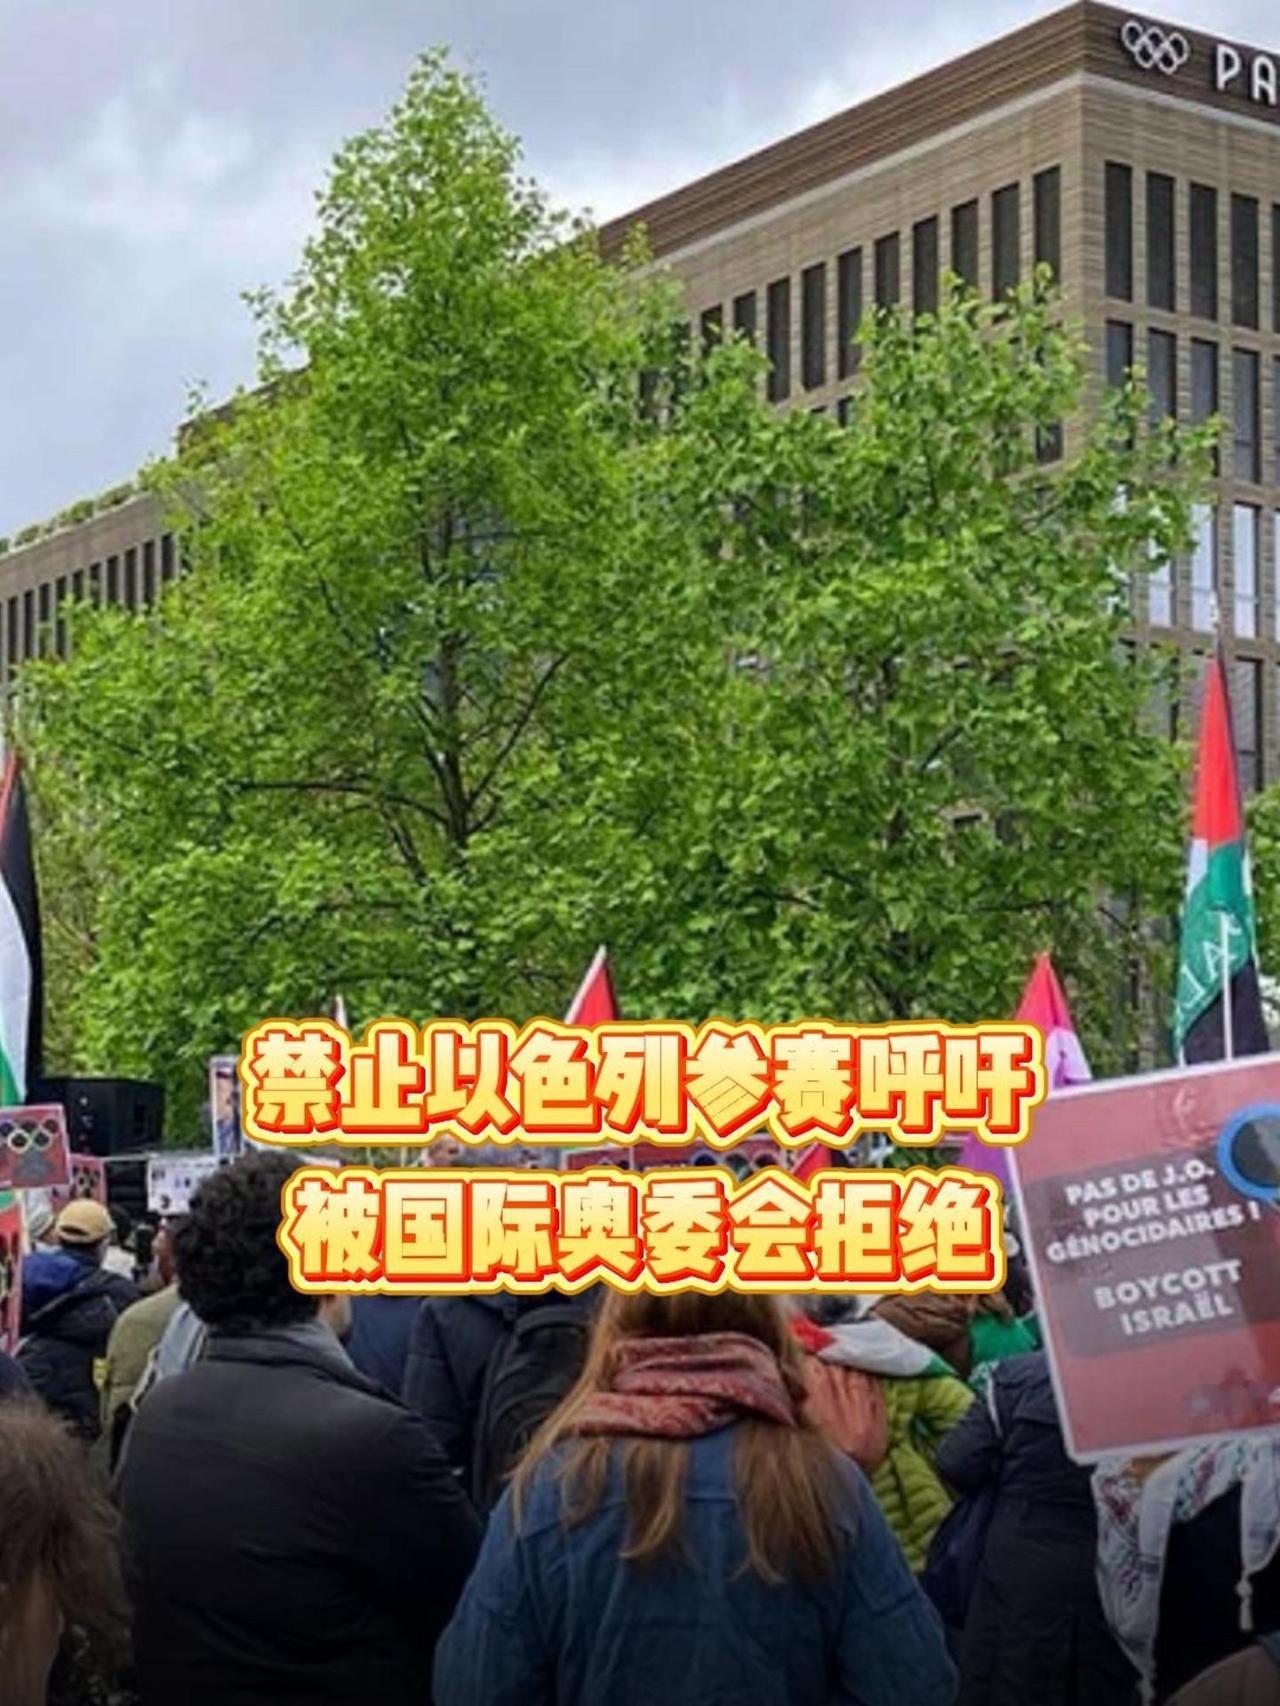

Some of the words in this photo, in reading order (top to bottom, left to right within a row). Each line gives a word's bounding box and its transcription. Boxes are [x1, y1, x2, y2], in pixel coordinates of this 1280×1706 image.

[1215, 43, 1277, 105] PA
[1065, 1176, 1117, 1205] PAS
[1121, 1168, 1159, 1193] DE
[1163, 1159, 1216, 1185] J.O.
[1083, 1195, 1161, 1228] POUR
[1163, 1183, 1211, 1210] LES
[1046, 1203, 1244, 1264] GÉNOCIDAIRES
[1094, 1258, 1242, 1309] BOYCOTT
[1120, 1290, 1234, 1336] ISRAËL
